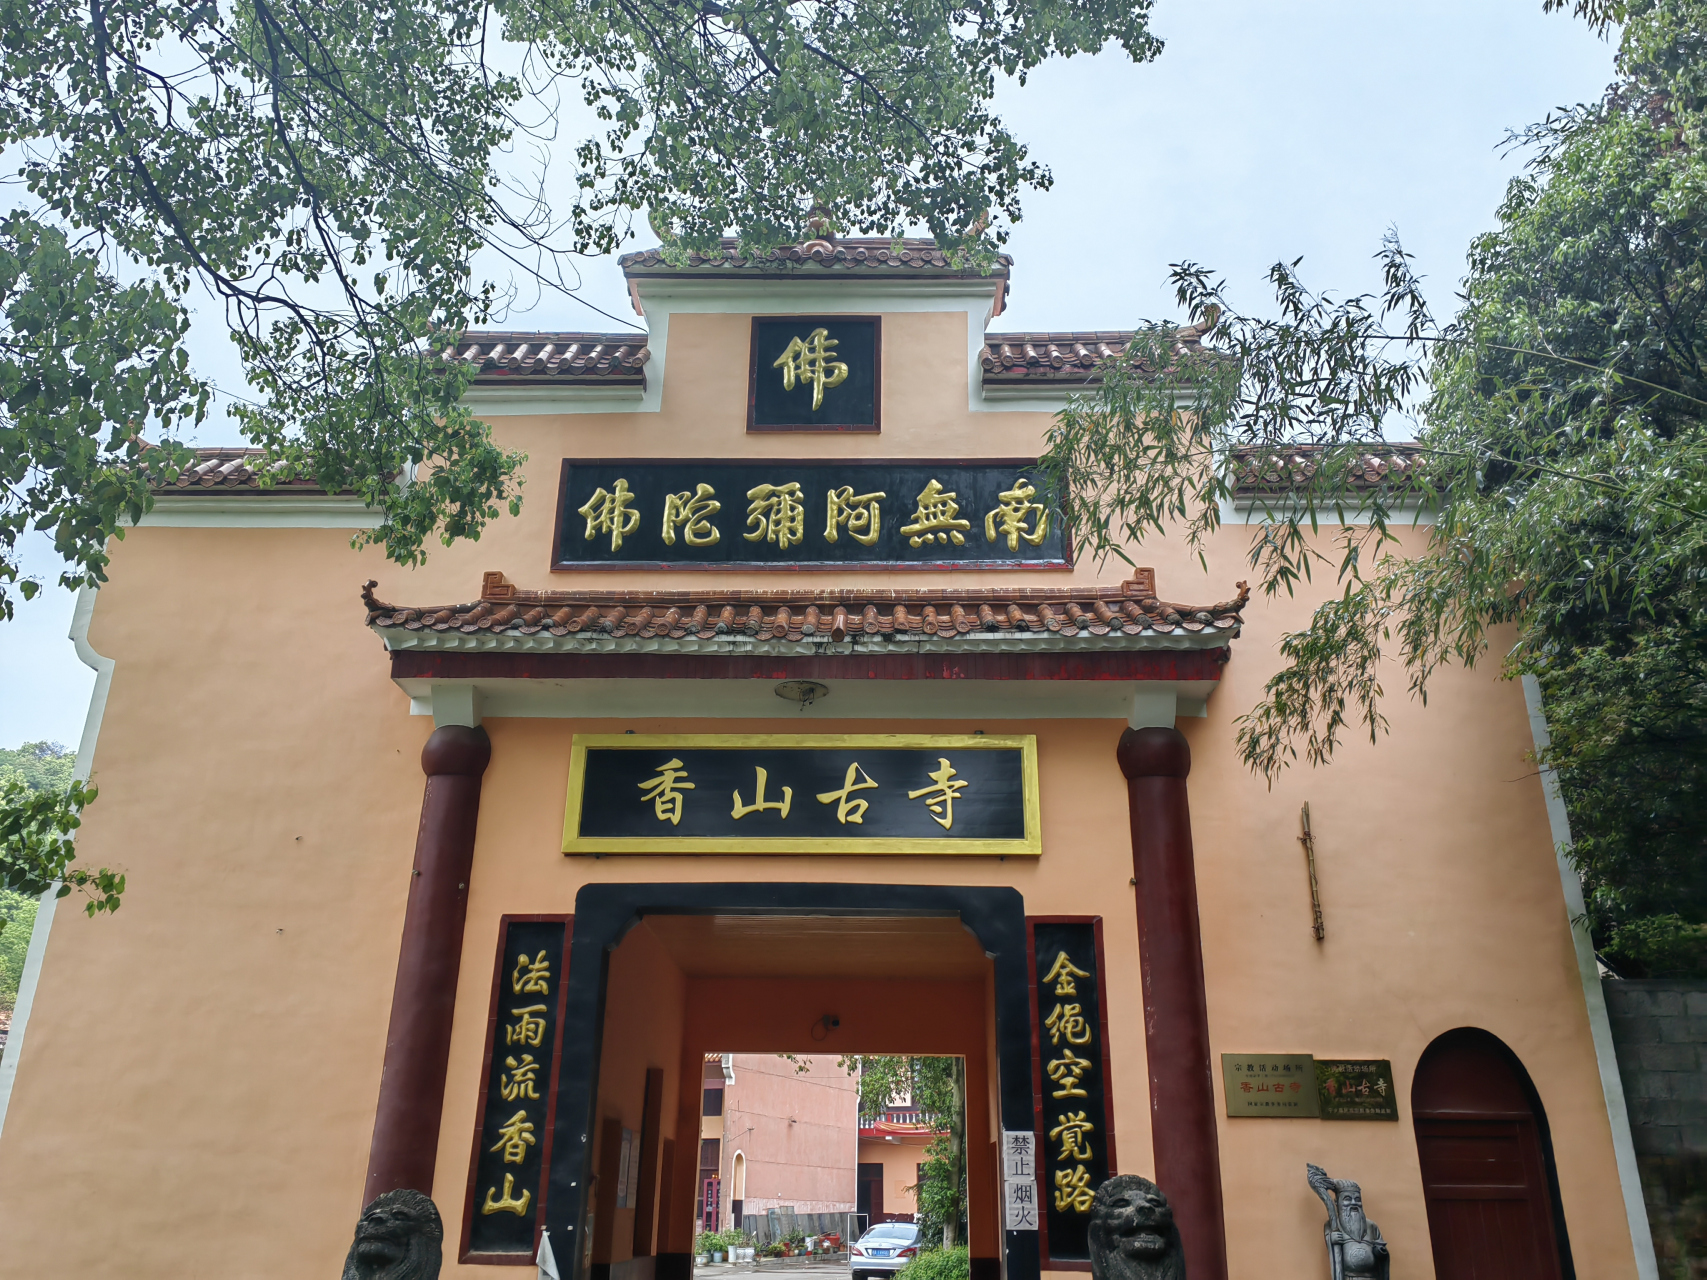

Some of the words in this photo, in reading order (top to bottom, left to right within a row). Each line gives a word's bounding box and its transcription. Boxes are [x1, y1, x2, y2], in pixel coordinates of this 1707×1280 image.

[773, 327, 849, 411] 佛
[637, 757, 969, 831] 香山古寺
[481, 950, 551, 1217] 法雨流香山
[1235, 1063, 1303, 1073] 宗教活动场所
[1240, 1081, 1302, 1094] 香山古寺
[1011, 1134, 1034, 1227] 禁止烟火
